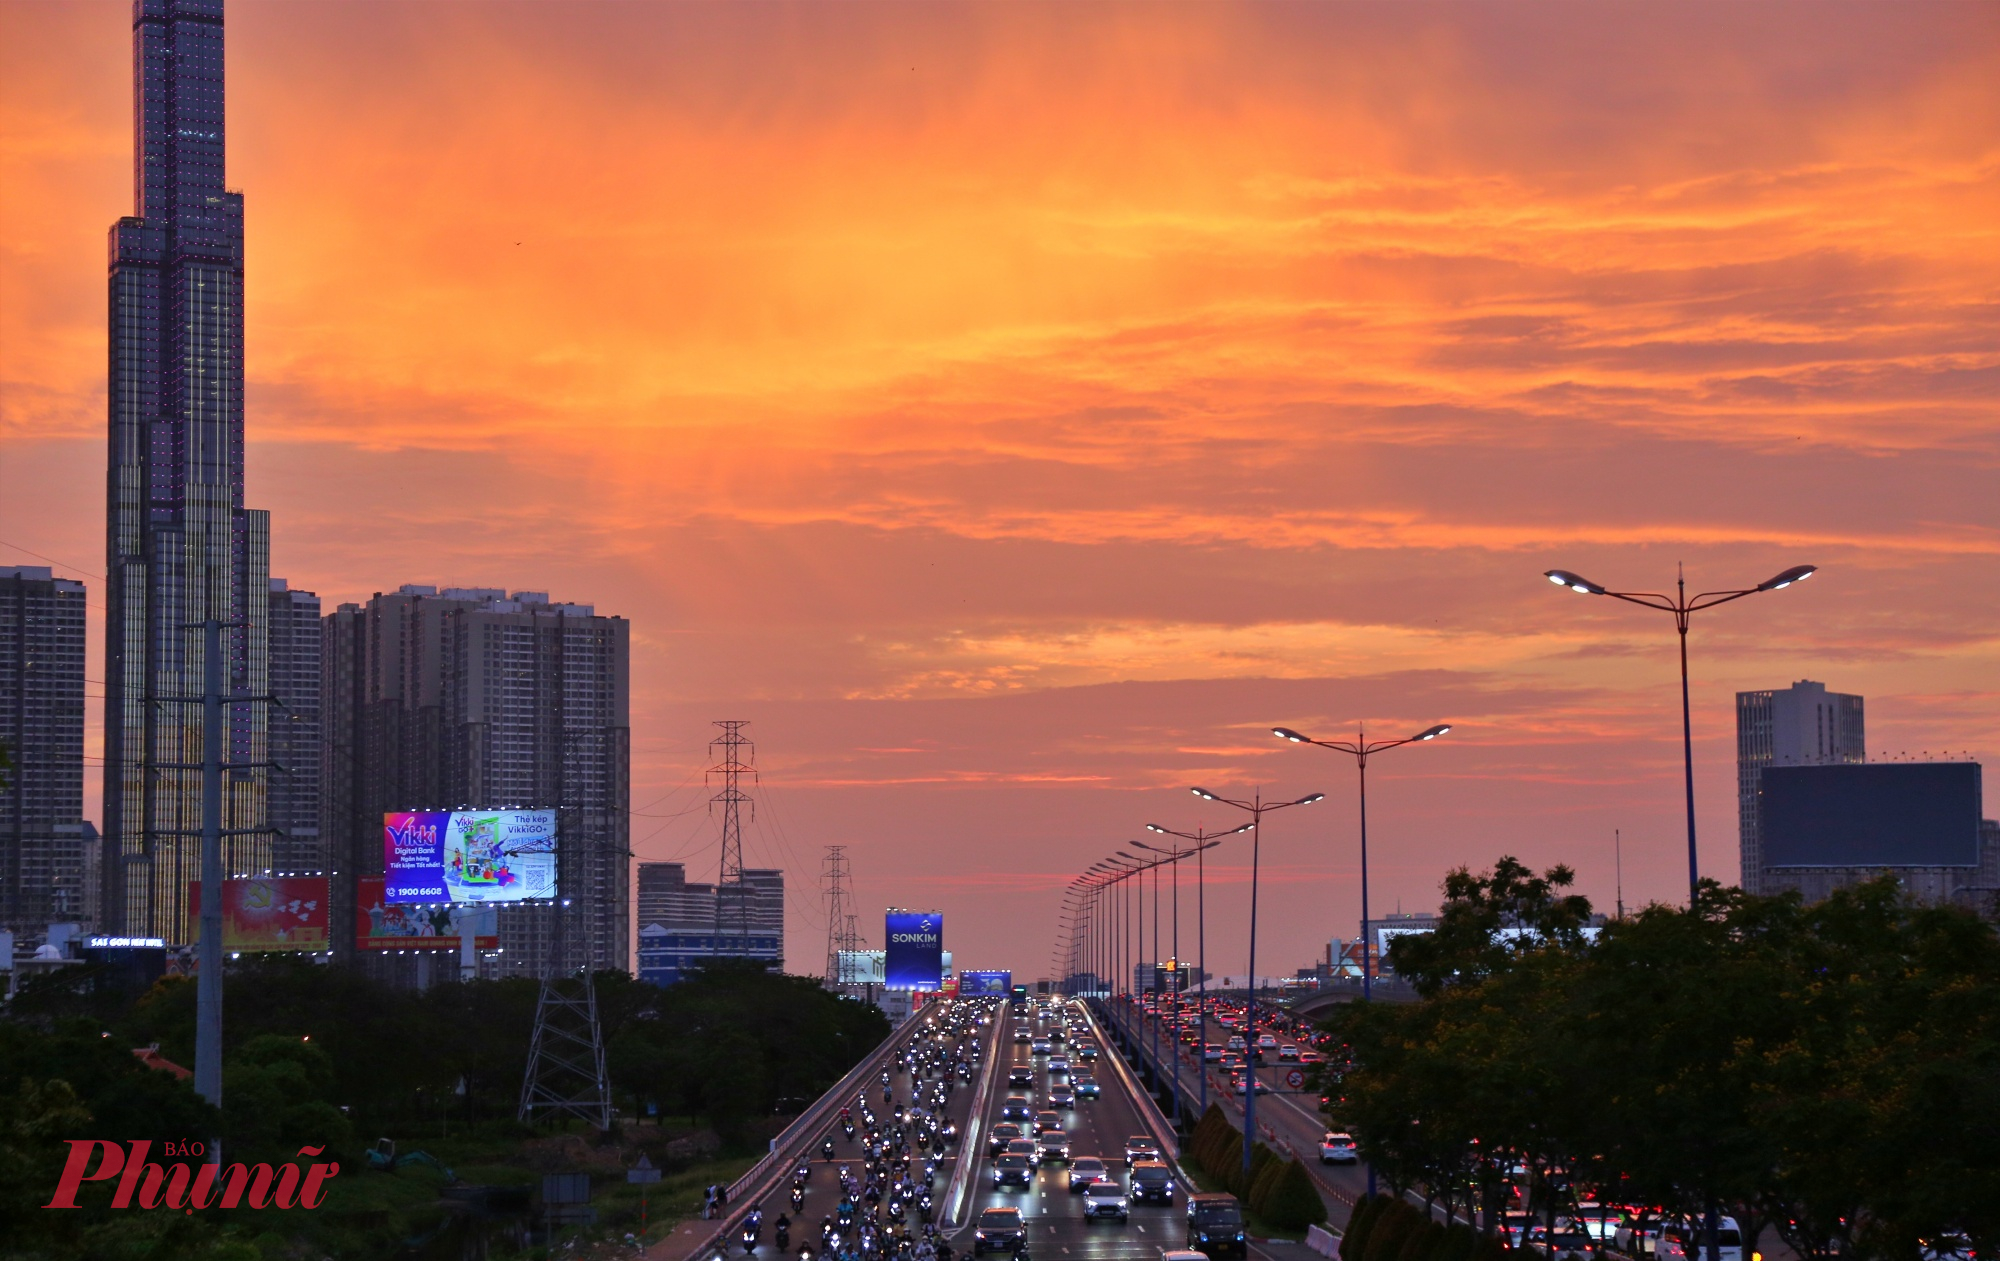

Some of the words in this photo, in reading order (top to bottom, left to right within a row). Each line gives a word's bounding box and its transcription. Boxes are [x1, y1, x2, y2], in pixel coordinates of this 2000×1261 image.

[455, 815, 474, 826] Vikki
[532, 814, 548, 823] kép
[386, 816, 437, 846] Vikki
[892, 934, 936, 942] SONKIM
